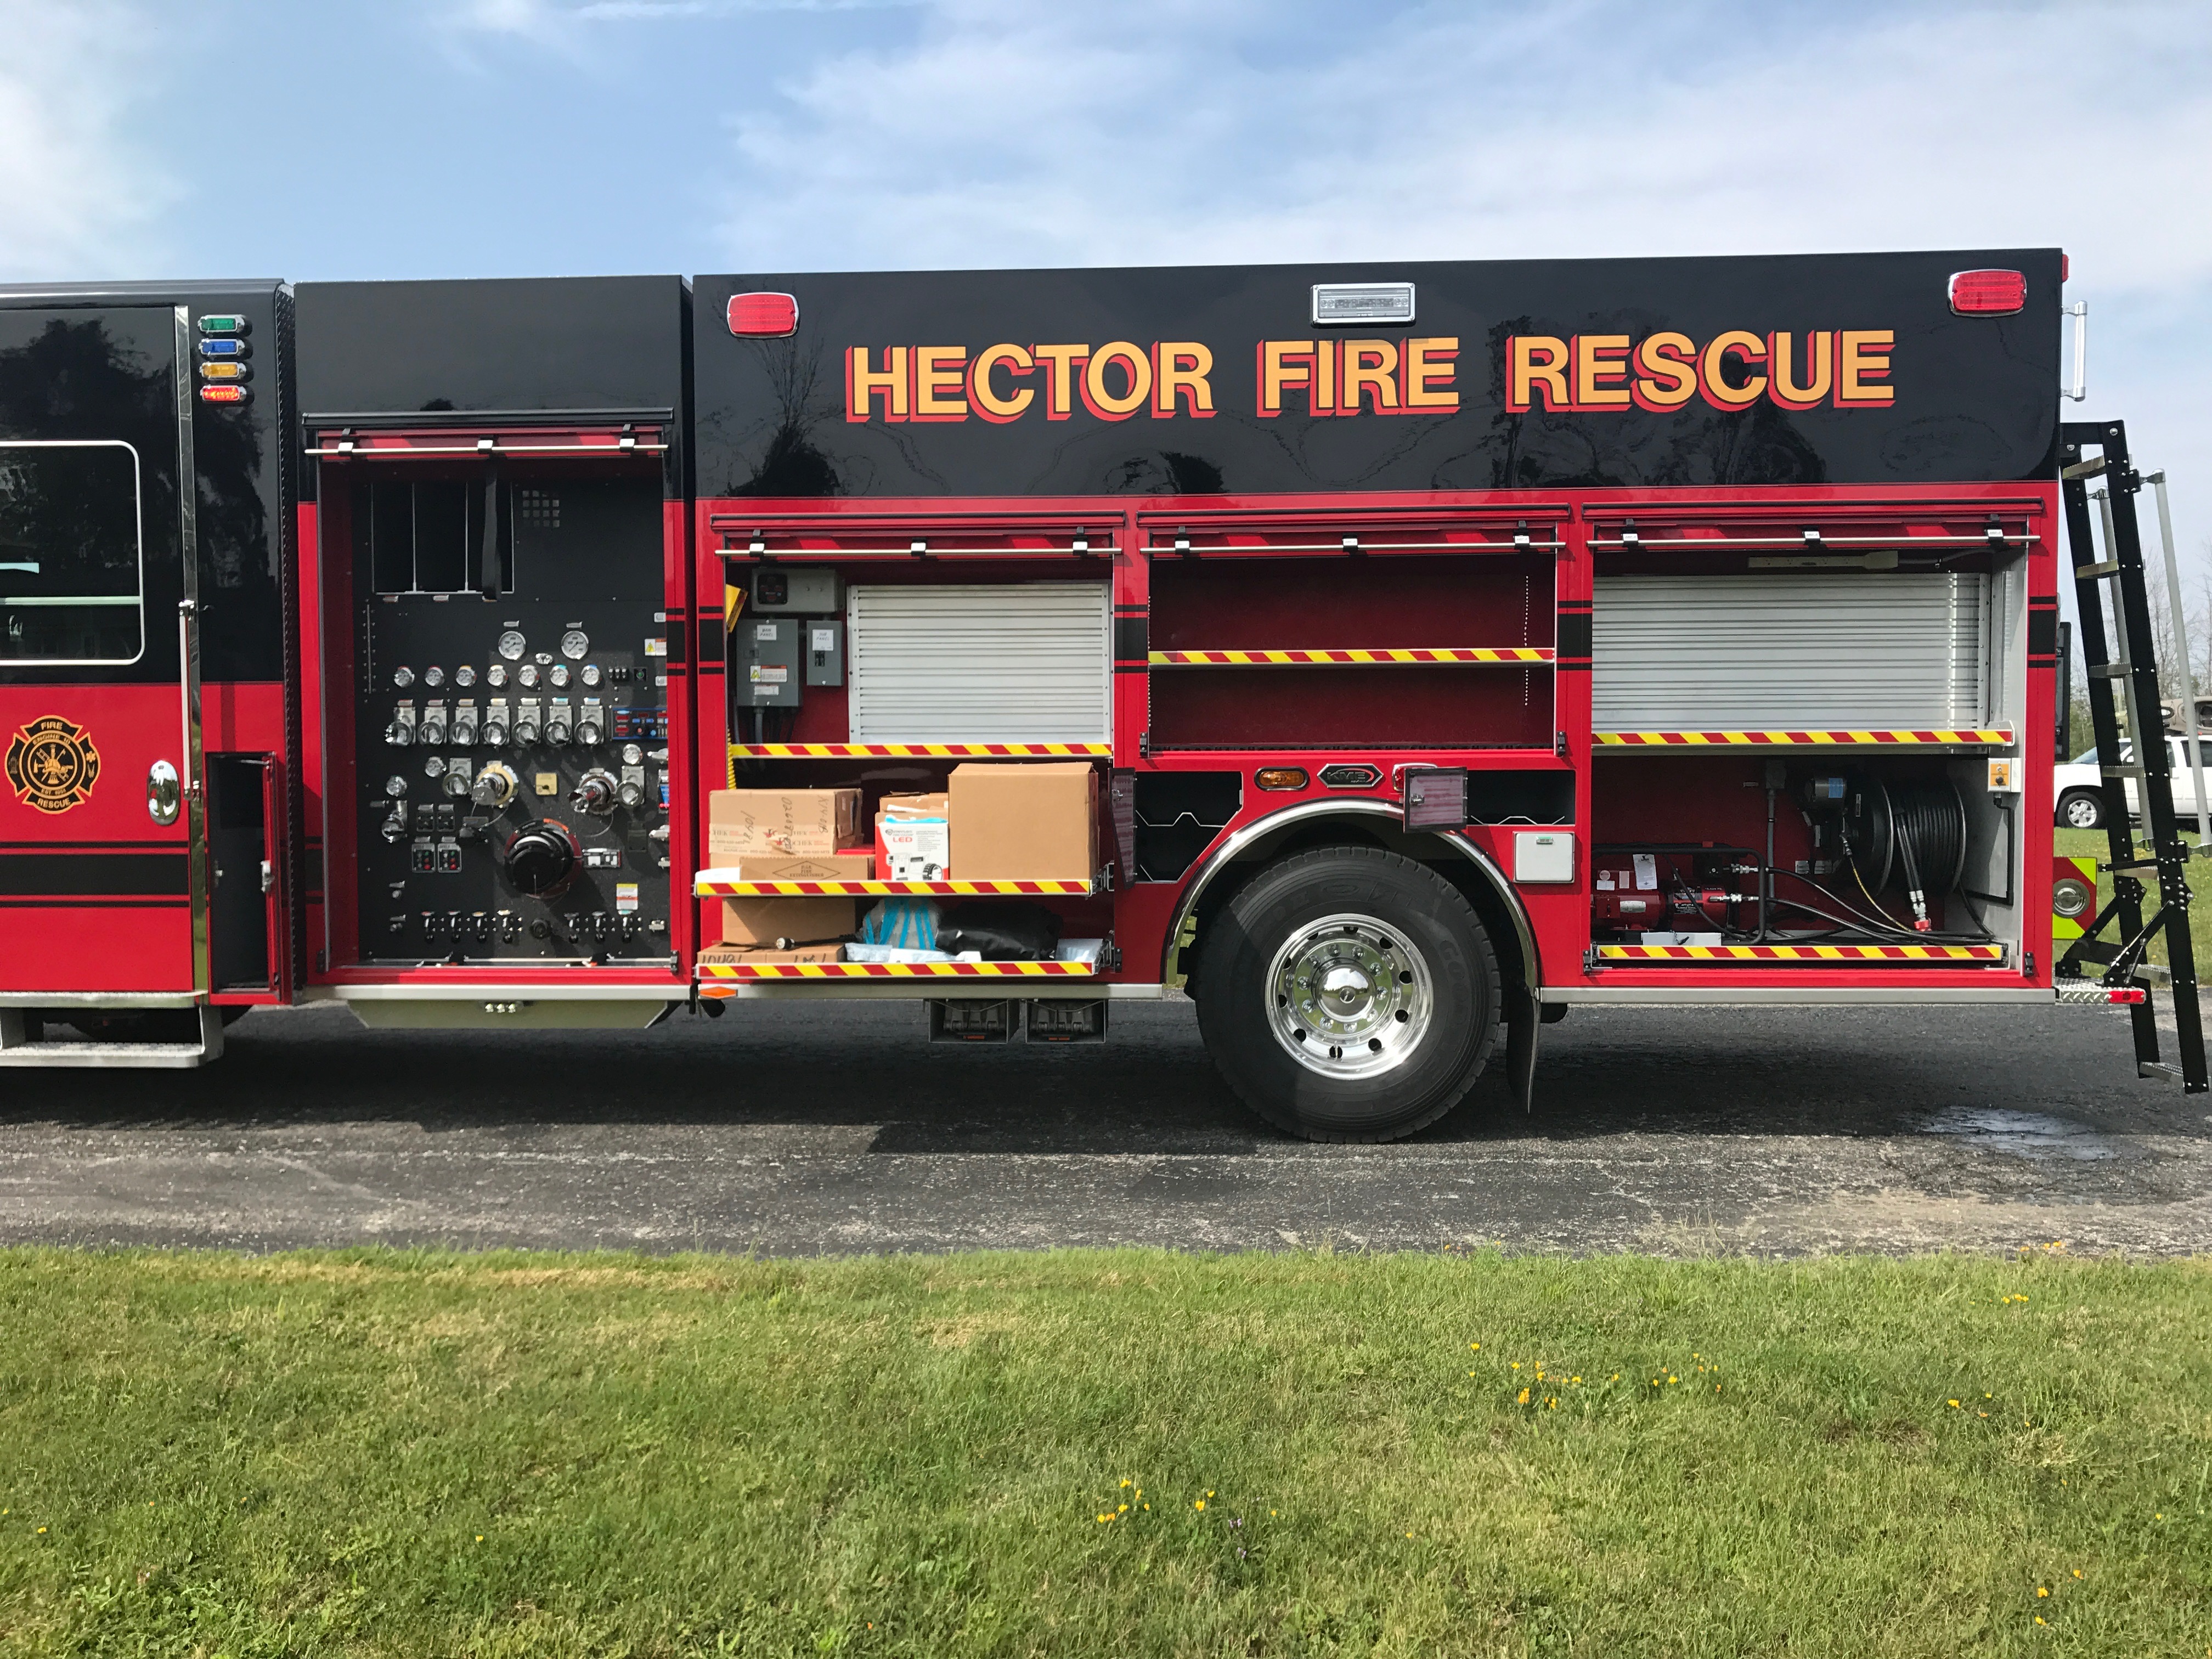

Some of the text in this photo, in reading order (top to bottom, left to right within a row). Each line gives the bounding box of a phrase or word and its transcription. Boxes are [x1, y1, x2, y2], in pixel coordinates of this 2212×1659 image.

[845, 330, 1895, 424] HECTOR FIRE RESCUE
[41, 721, 63, 730] FIRE
[32, 733, 60, 745] ENGINE
[1327, 772, 1365, 780] KME
[37, 797, 71, 809] RESCUE
